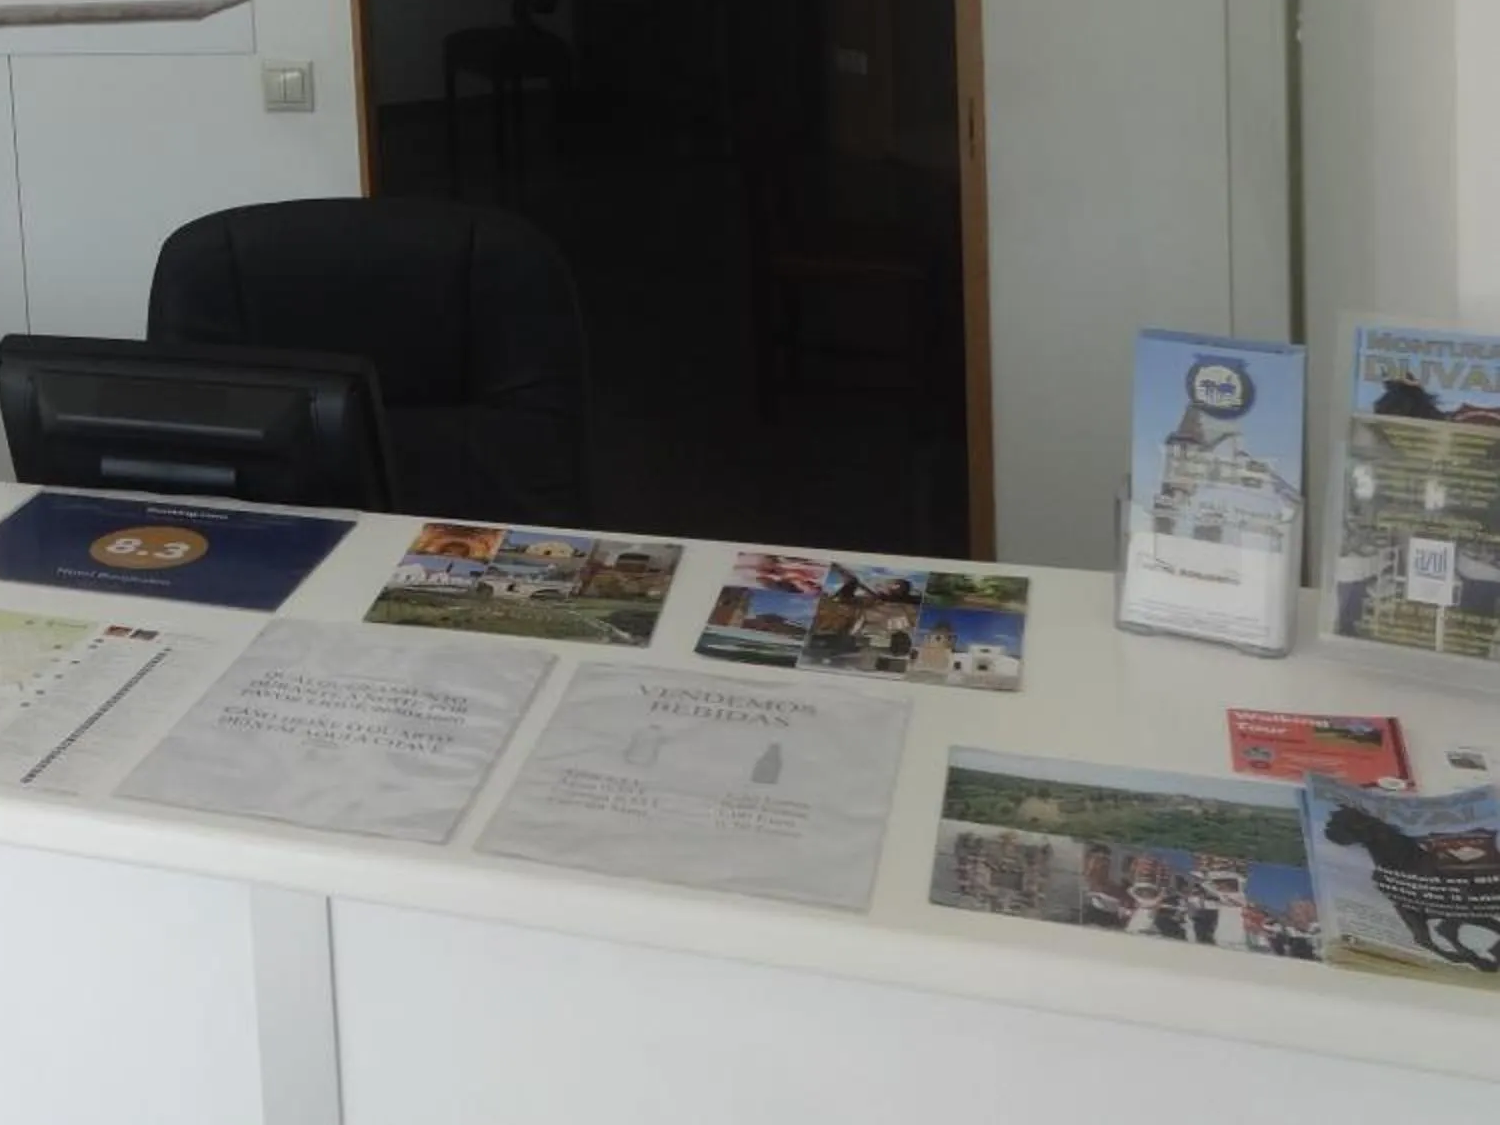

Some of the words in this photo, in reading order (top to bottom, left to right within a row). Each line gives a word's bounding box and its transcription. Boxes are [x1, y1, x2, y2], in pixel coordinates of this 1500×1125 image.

[105, 538, 192, 560] 8.3
[635, 683, 817, 715] VENDEMOS
[646, 699, 791, 728] BEBIDAS
